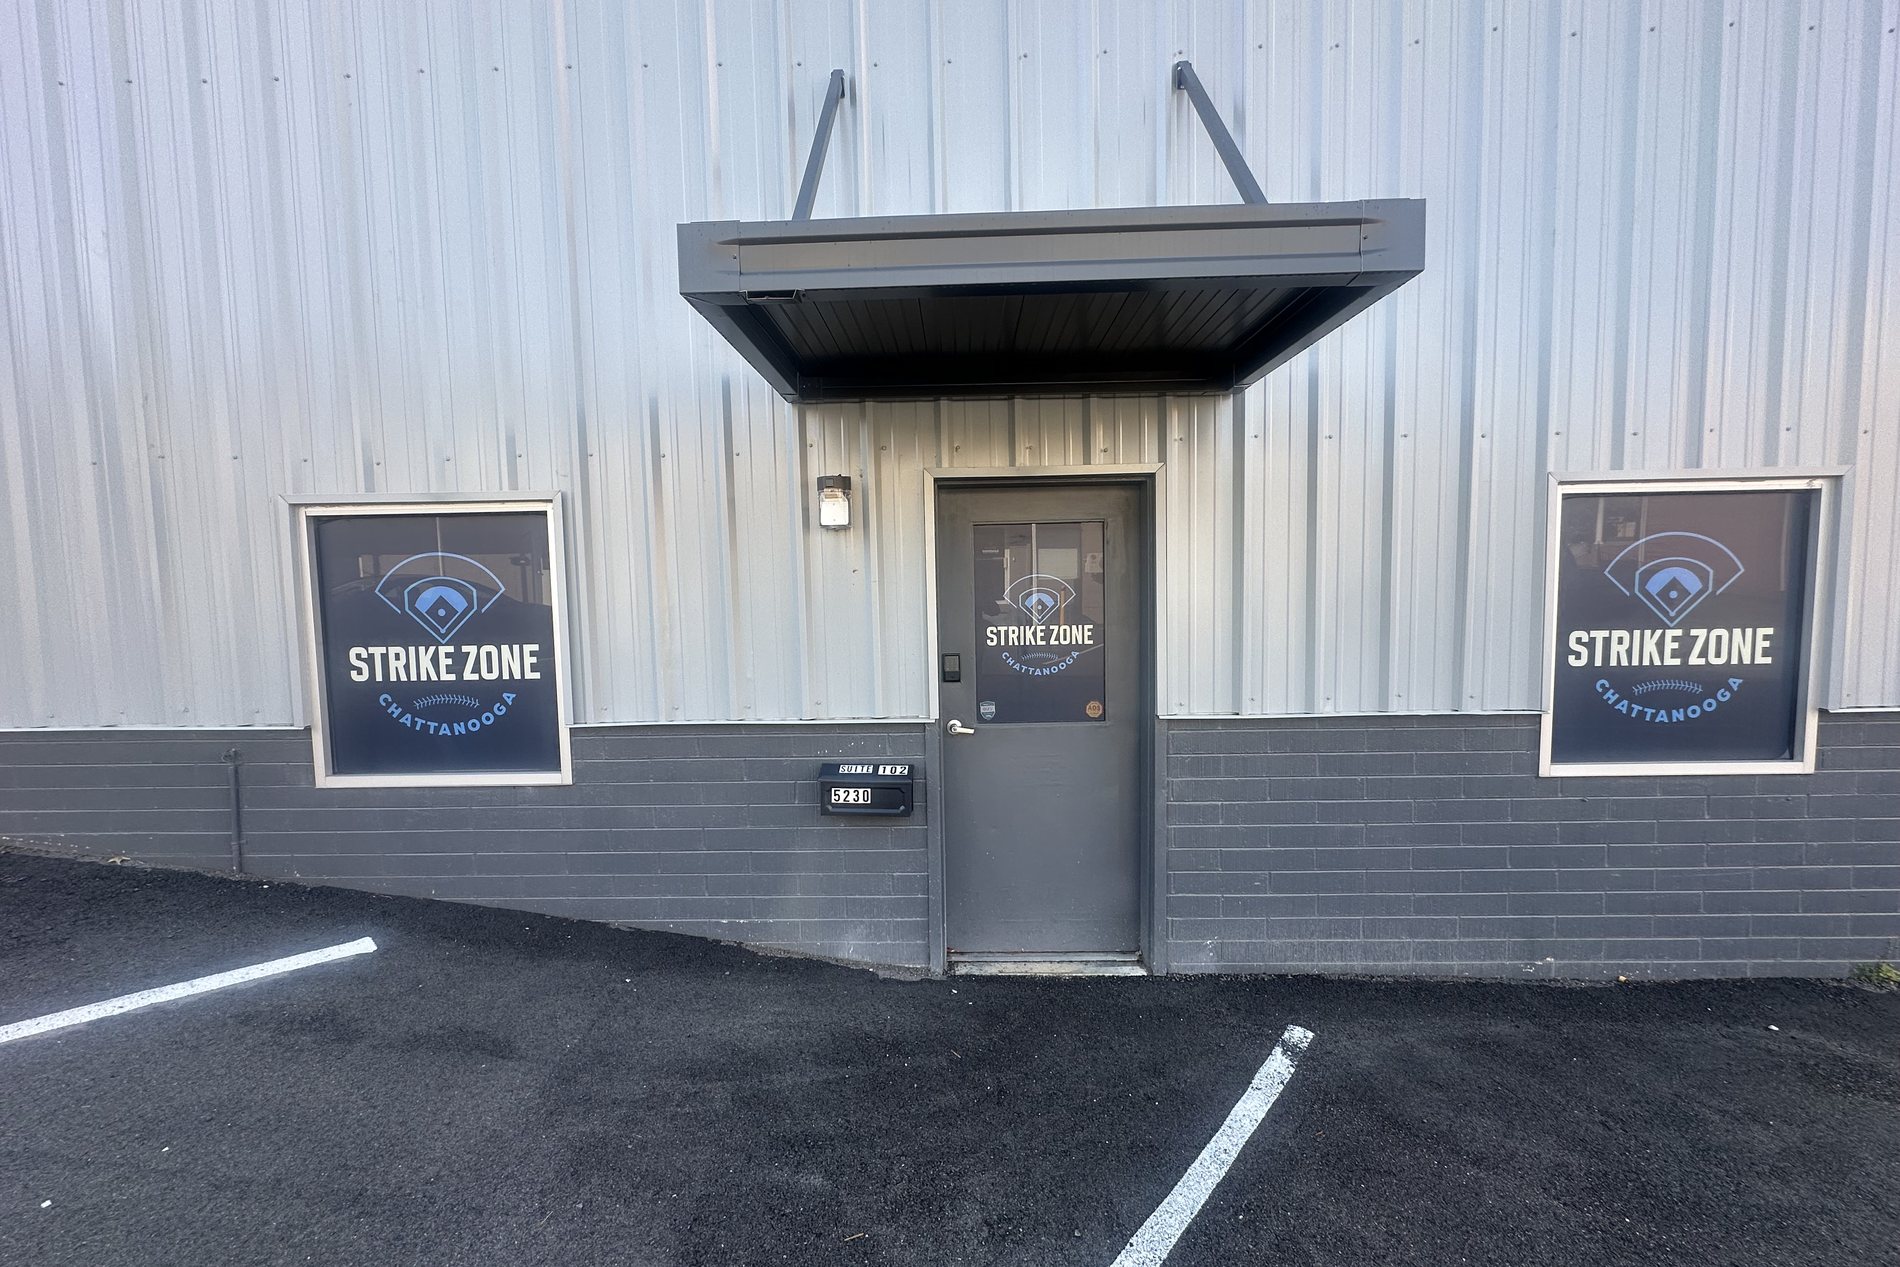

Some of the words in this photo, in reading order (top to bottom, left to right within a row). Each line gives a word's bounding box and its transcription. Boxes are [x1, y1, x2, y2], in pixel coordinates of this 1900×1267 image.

[986, 625, 1046, 645] STRIKE
[1050, 625, 1093, 644] ZONE
[1568, 630, 1681, 667] STRIKE
[1688, 628, 1774, 665] ZONE
[349, 646, 456, 682] STRIKE
[462, 644, 541, 681] ZONE
[1001, 651, 1080, 675] CHATTANOOGA
[379, 692, 517, 736] CHATTANOOGA
[1595, 677, 1743, 722] CHATTANOOGA
[840, 765, 873, 773] SUITE
[881, 765, 907, 775] 102
[833, 790, 869, 802] 5230
